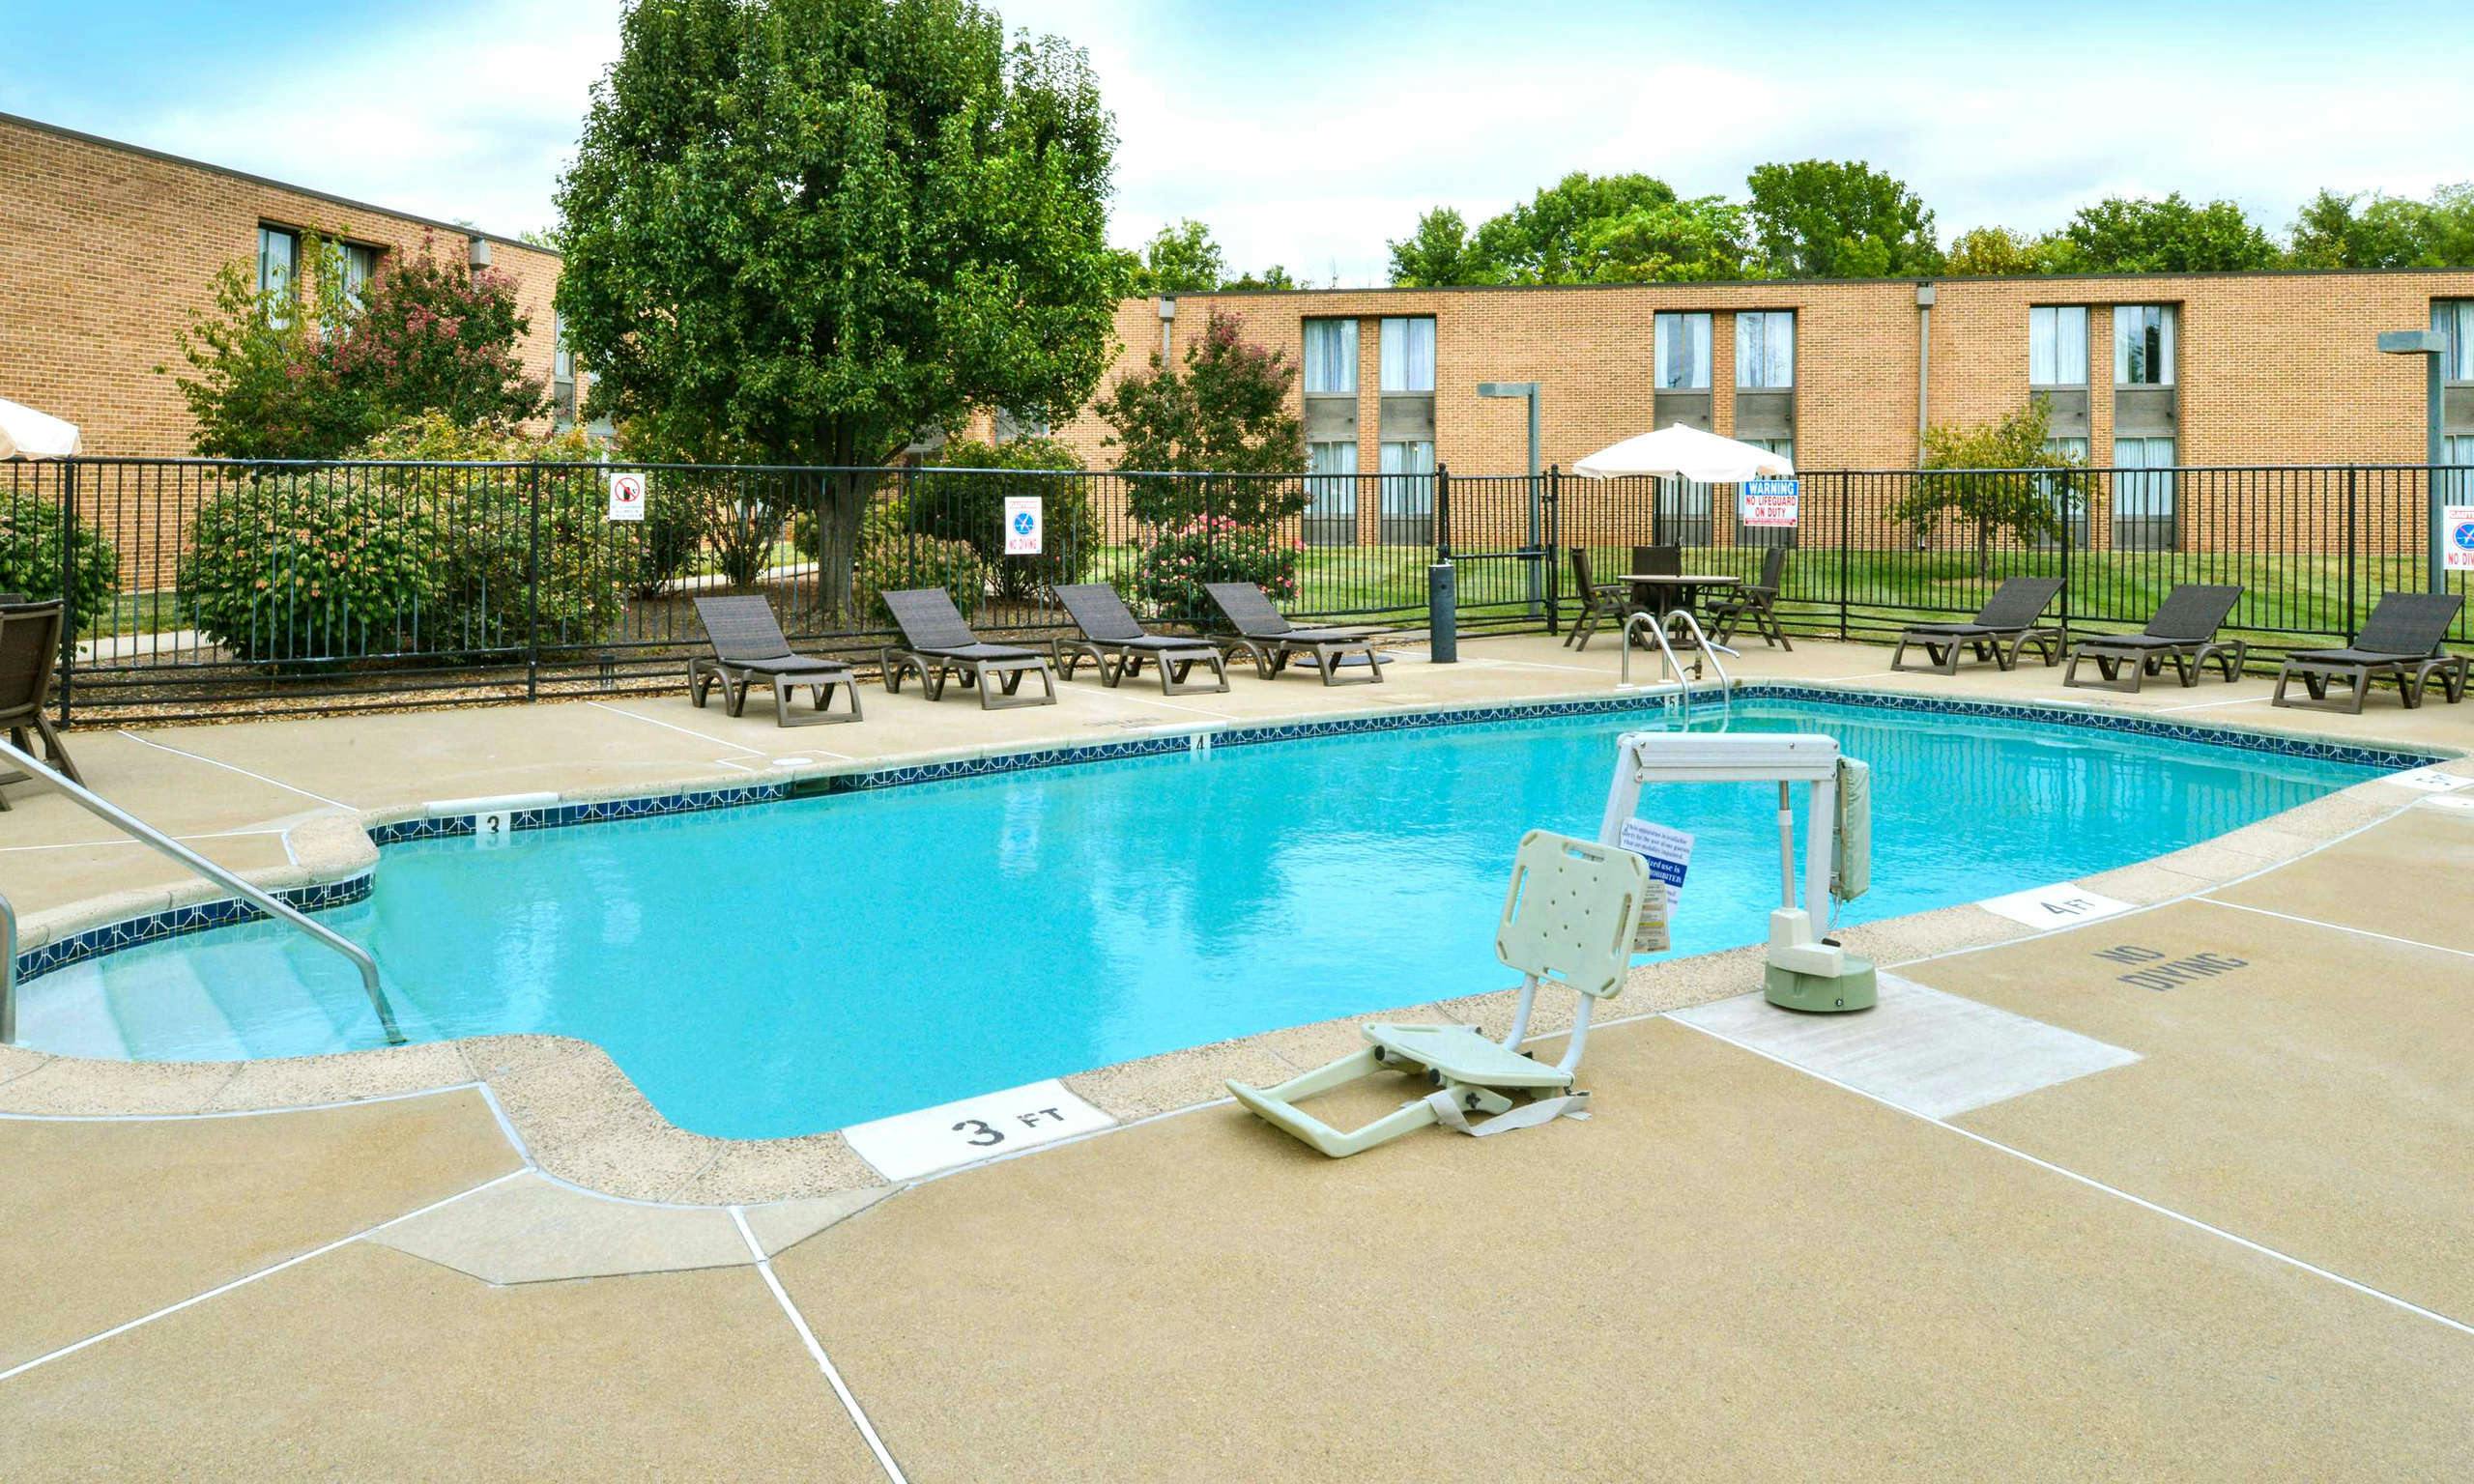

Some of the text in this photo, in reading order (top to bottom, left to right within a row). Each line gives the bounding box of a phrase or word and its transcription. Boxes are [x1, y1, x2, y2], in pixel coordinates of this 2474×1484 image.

[1749, 482, 1795, 495] WARNING
[1745, 496, 1796, 506] NO LIFEGUARD
[1754, 507, 1786, 517] ON DUTY
[2448, 552, 2460, 565] NO
[1669, 696, 1676, 709] 5
[1196, 734, 1204, 750] 4
[487, 815, 500, 835] 3
[1661, 863, 1674, 872] use
[1674, 865, 1681, 873] is
[2040, 899, 2095, 915] 4 FT
[2089, 945, 2166, 965] NO
[2115, 952, 2250, 991] DIVING
[951, 1107, 1065, 1147] 3 FT
